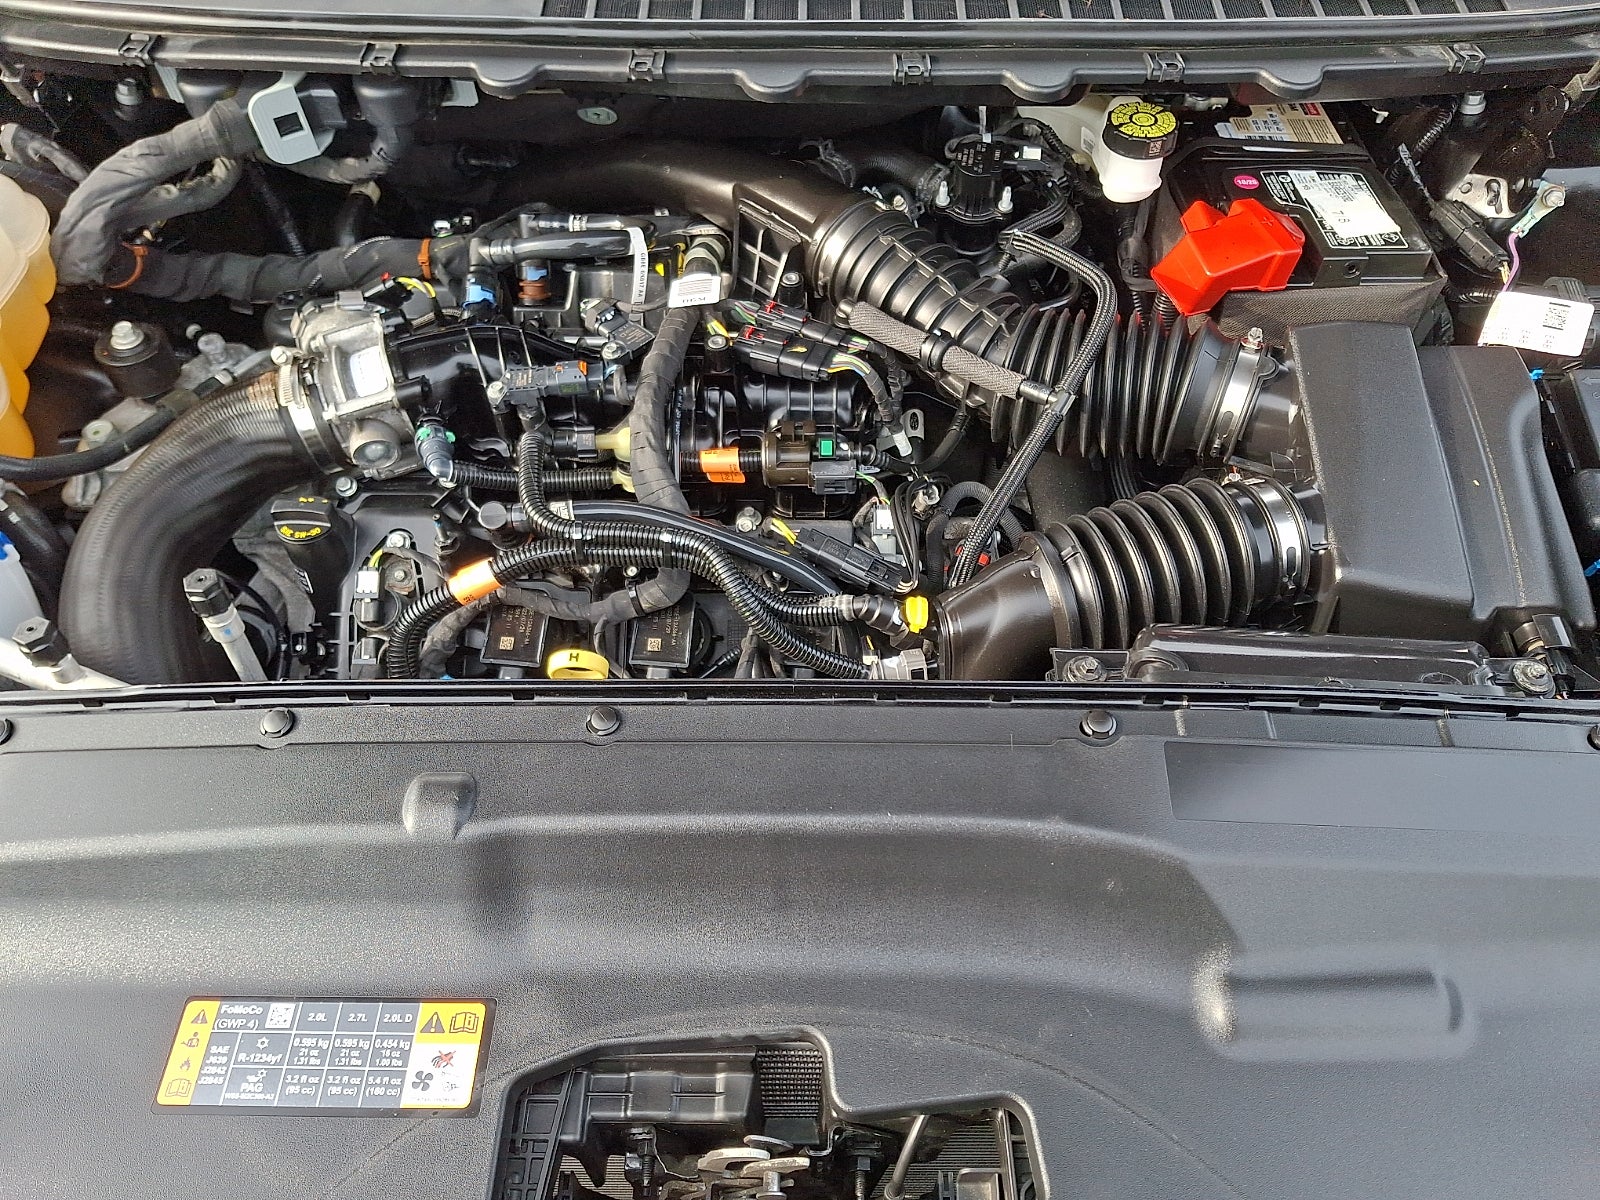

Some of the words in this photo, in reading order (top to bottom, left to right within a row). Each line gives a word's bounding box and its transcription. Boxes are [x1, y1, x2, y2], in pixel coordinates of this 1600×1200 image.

[569, 652, 579, 663] H
[220, 1004, 264, 1015] FoMoCo
[307, 1012, 327, 1022] 2.0L
[347, 1013, 368, 1023] 2.7L
[383, 1013, 403, 1023] 2.0L
[404, 1013, 413, 1023] D
[214, 1019, 246, 1031] (GWP
[246, 1019, 259, 1031] 4)
[318, 1038, 330, 1050] kg
[359, 1038, 370, 1050] kg
[374, 1039, 398, 1049] 0.454
[399, 1039, 411, 1051] kg
[210, 1045, 230, 1054] SAE
[299, 1048, 309, 1056] 21
[340, 1048, 350, 1057] 21
[391, 1050, 401, 1058] oz
[237, 1052, 283, 1065] R-1234yf
[375, 1058, 390, 1067] 1.00
[240, 1082, 263, 1092] PAG
[301, 1086, 316, 1096] cc)
[342, 1086, 358, 1097] cc)
[386, 1087, 401, 1098] cc)
